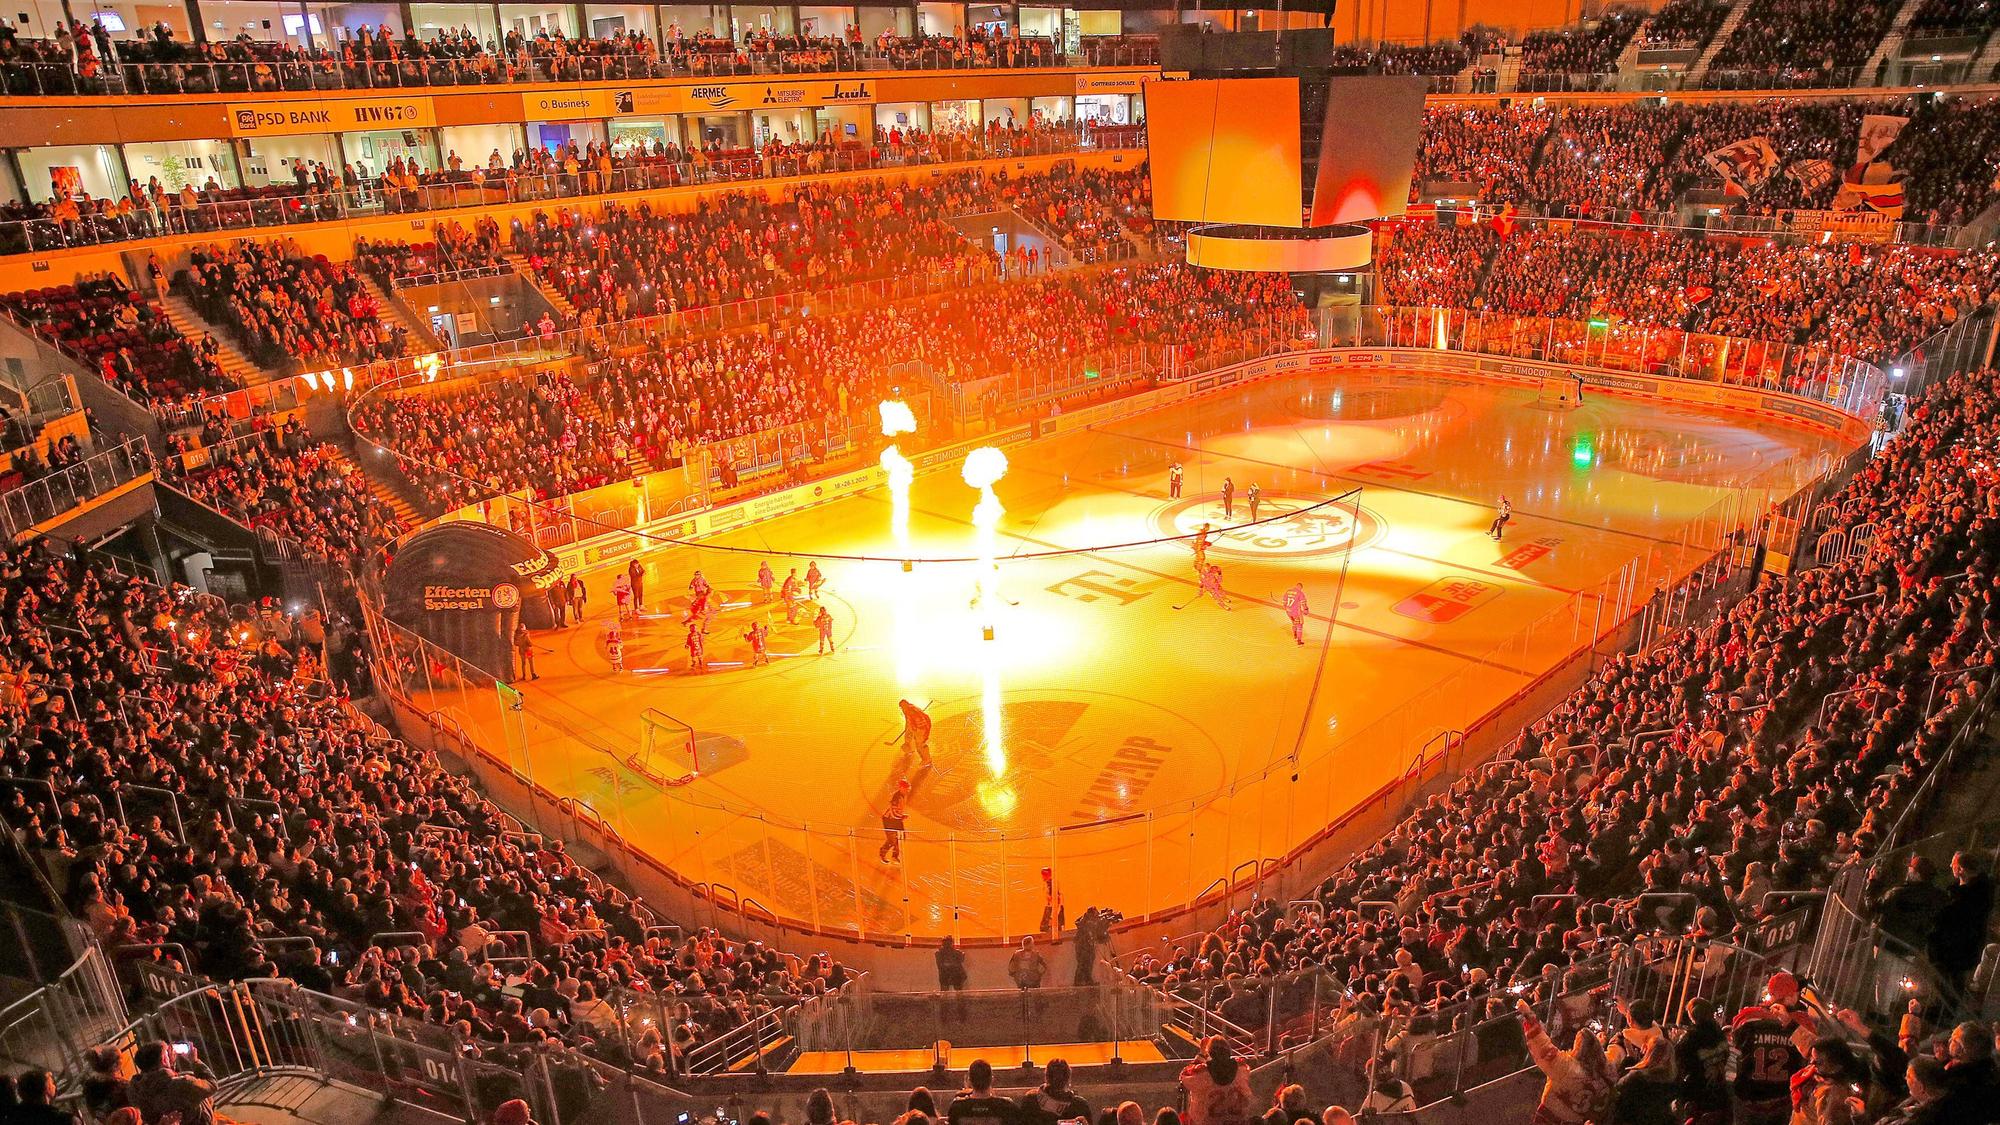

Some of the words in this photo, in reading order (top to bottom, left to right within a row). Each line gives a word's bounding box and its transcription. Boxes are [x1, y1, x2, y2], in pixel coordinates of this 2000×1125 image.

[691, 87, 727, 100] AERMEC
[777, 89, 806, 97] MITSUBISHI
[552, 99, 590, 108] Business
[257, 113, 285, 125] PSD
[290, 111, 331, 124] BANK
[354, 106, 403, 122] HW67
[1513, 366, 1551, 377] TIMOCOM
[602, 542, 632, 555] MERKUR
[425, 585, 491, 598] Effecten
[425, 598, 484, 610] Spiegel
[1766, 920, 1796, 948] 013
[149, 973, 180, 997] 014
[1752, 1047, 1789, 1081] 12
